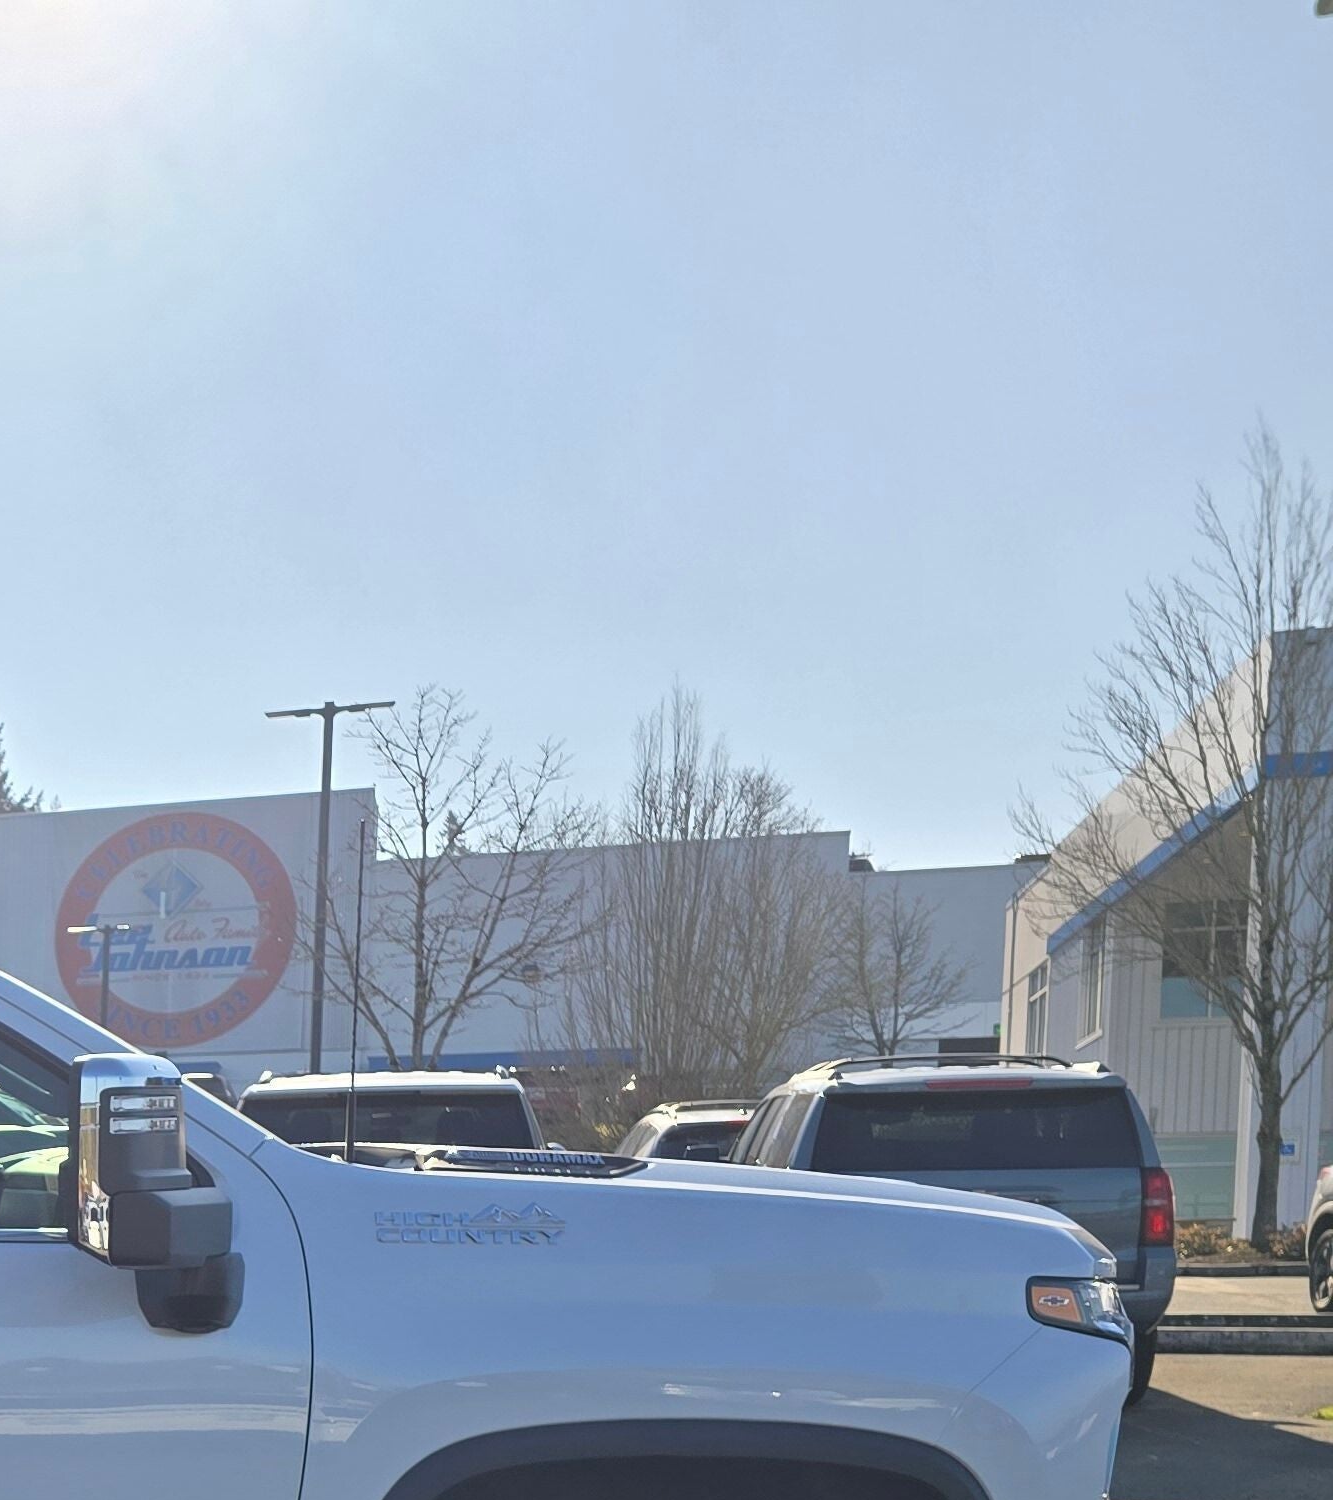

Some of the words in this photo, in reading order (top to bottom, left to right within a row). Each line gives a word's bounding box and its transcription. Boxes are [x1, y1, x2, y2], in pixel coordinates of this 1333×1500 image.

[77, 820, 277, 899] CELEBRATING
[164, 918, 207, 943] Auto
[211, 916, 269, 940] Fami
[82, 939, 255, 973] Johnson
[512, 1152, 605, 1165] DURAMAX
[374, 1211, 469, 1227] HIGH
[376, 1228, 564, 1244] COUNTRY
